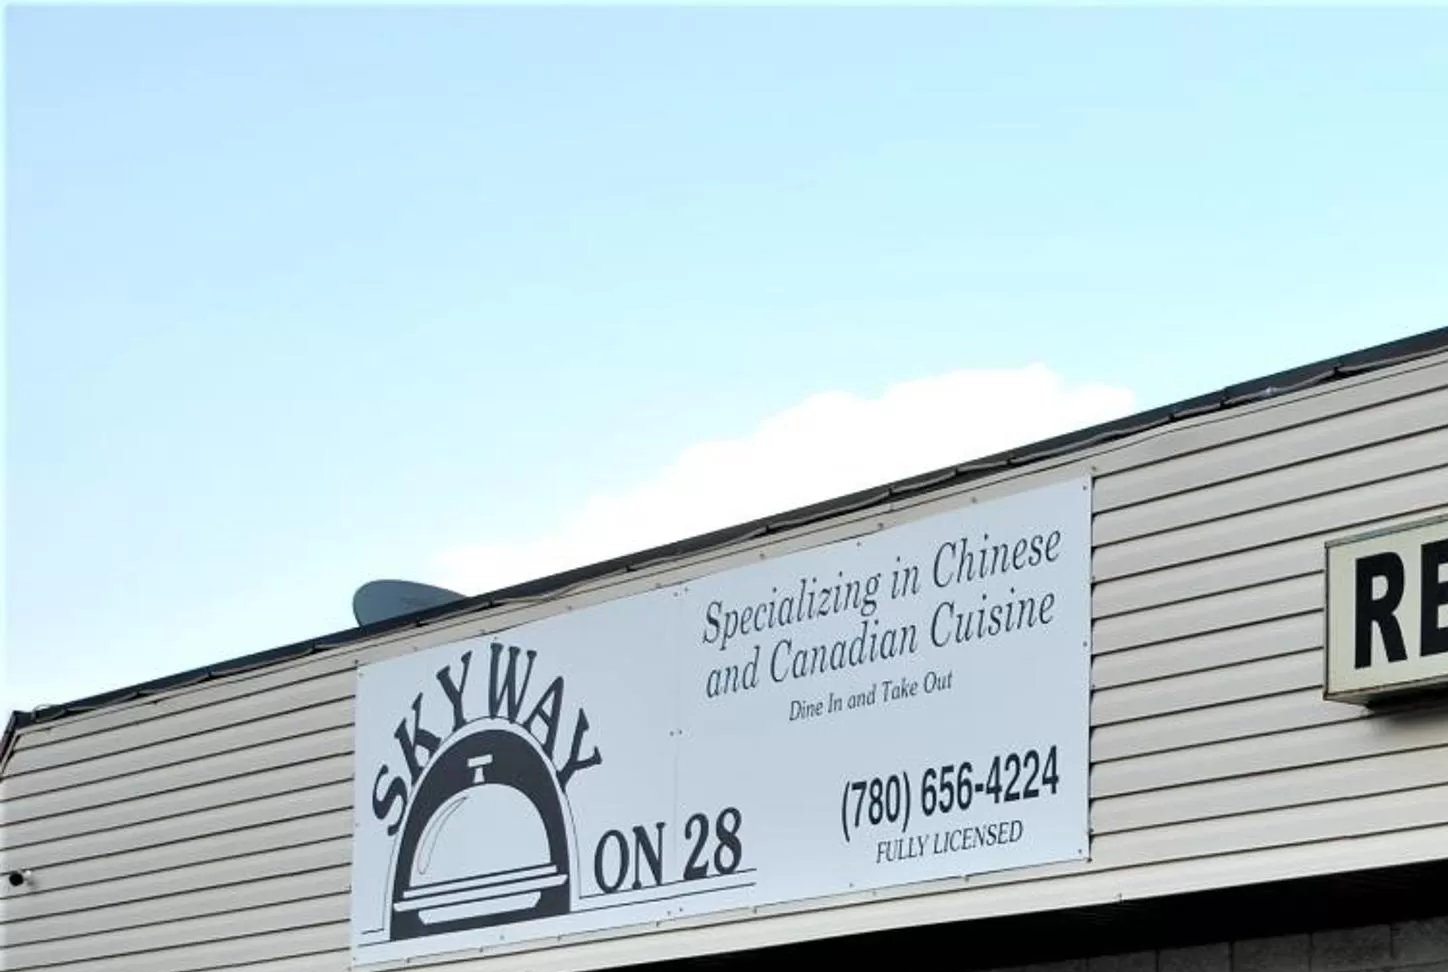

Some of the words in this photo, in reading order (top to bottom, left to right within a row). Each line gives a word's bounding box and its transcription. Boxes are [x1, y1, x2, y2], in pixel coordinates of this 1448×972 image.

[703, 572, 881, 650] Specializing
[891, 556, 920, 599] in
[933, 529, 1061, 588] Chinese
[706, 646, 759, 699] and
[769, 620, 918, 683] Canadian
[930, 587, 1055, 647] Cuisine
[372, 642, 602, 837] SKYWAY
[788, 700, 824, 721] Dine
[828, 692, 843, 713] In
[847, 684, 876, 709] and
[881, 677, 918, 703] Take
[924, 671, 953, 694] Out
[841, 772, 911, 841] (780)
[921, 745, 1060, 817] 656-4224
[875, 835, 929, 863] FULLY
[934, 819, 1024, 854] LICENSED
[593, 822, 665, 894] ON
[683, 807, 742, 880] 28
